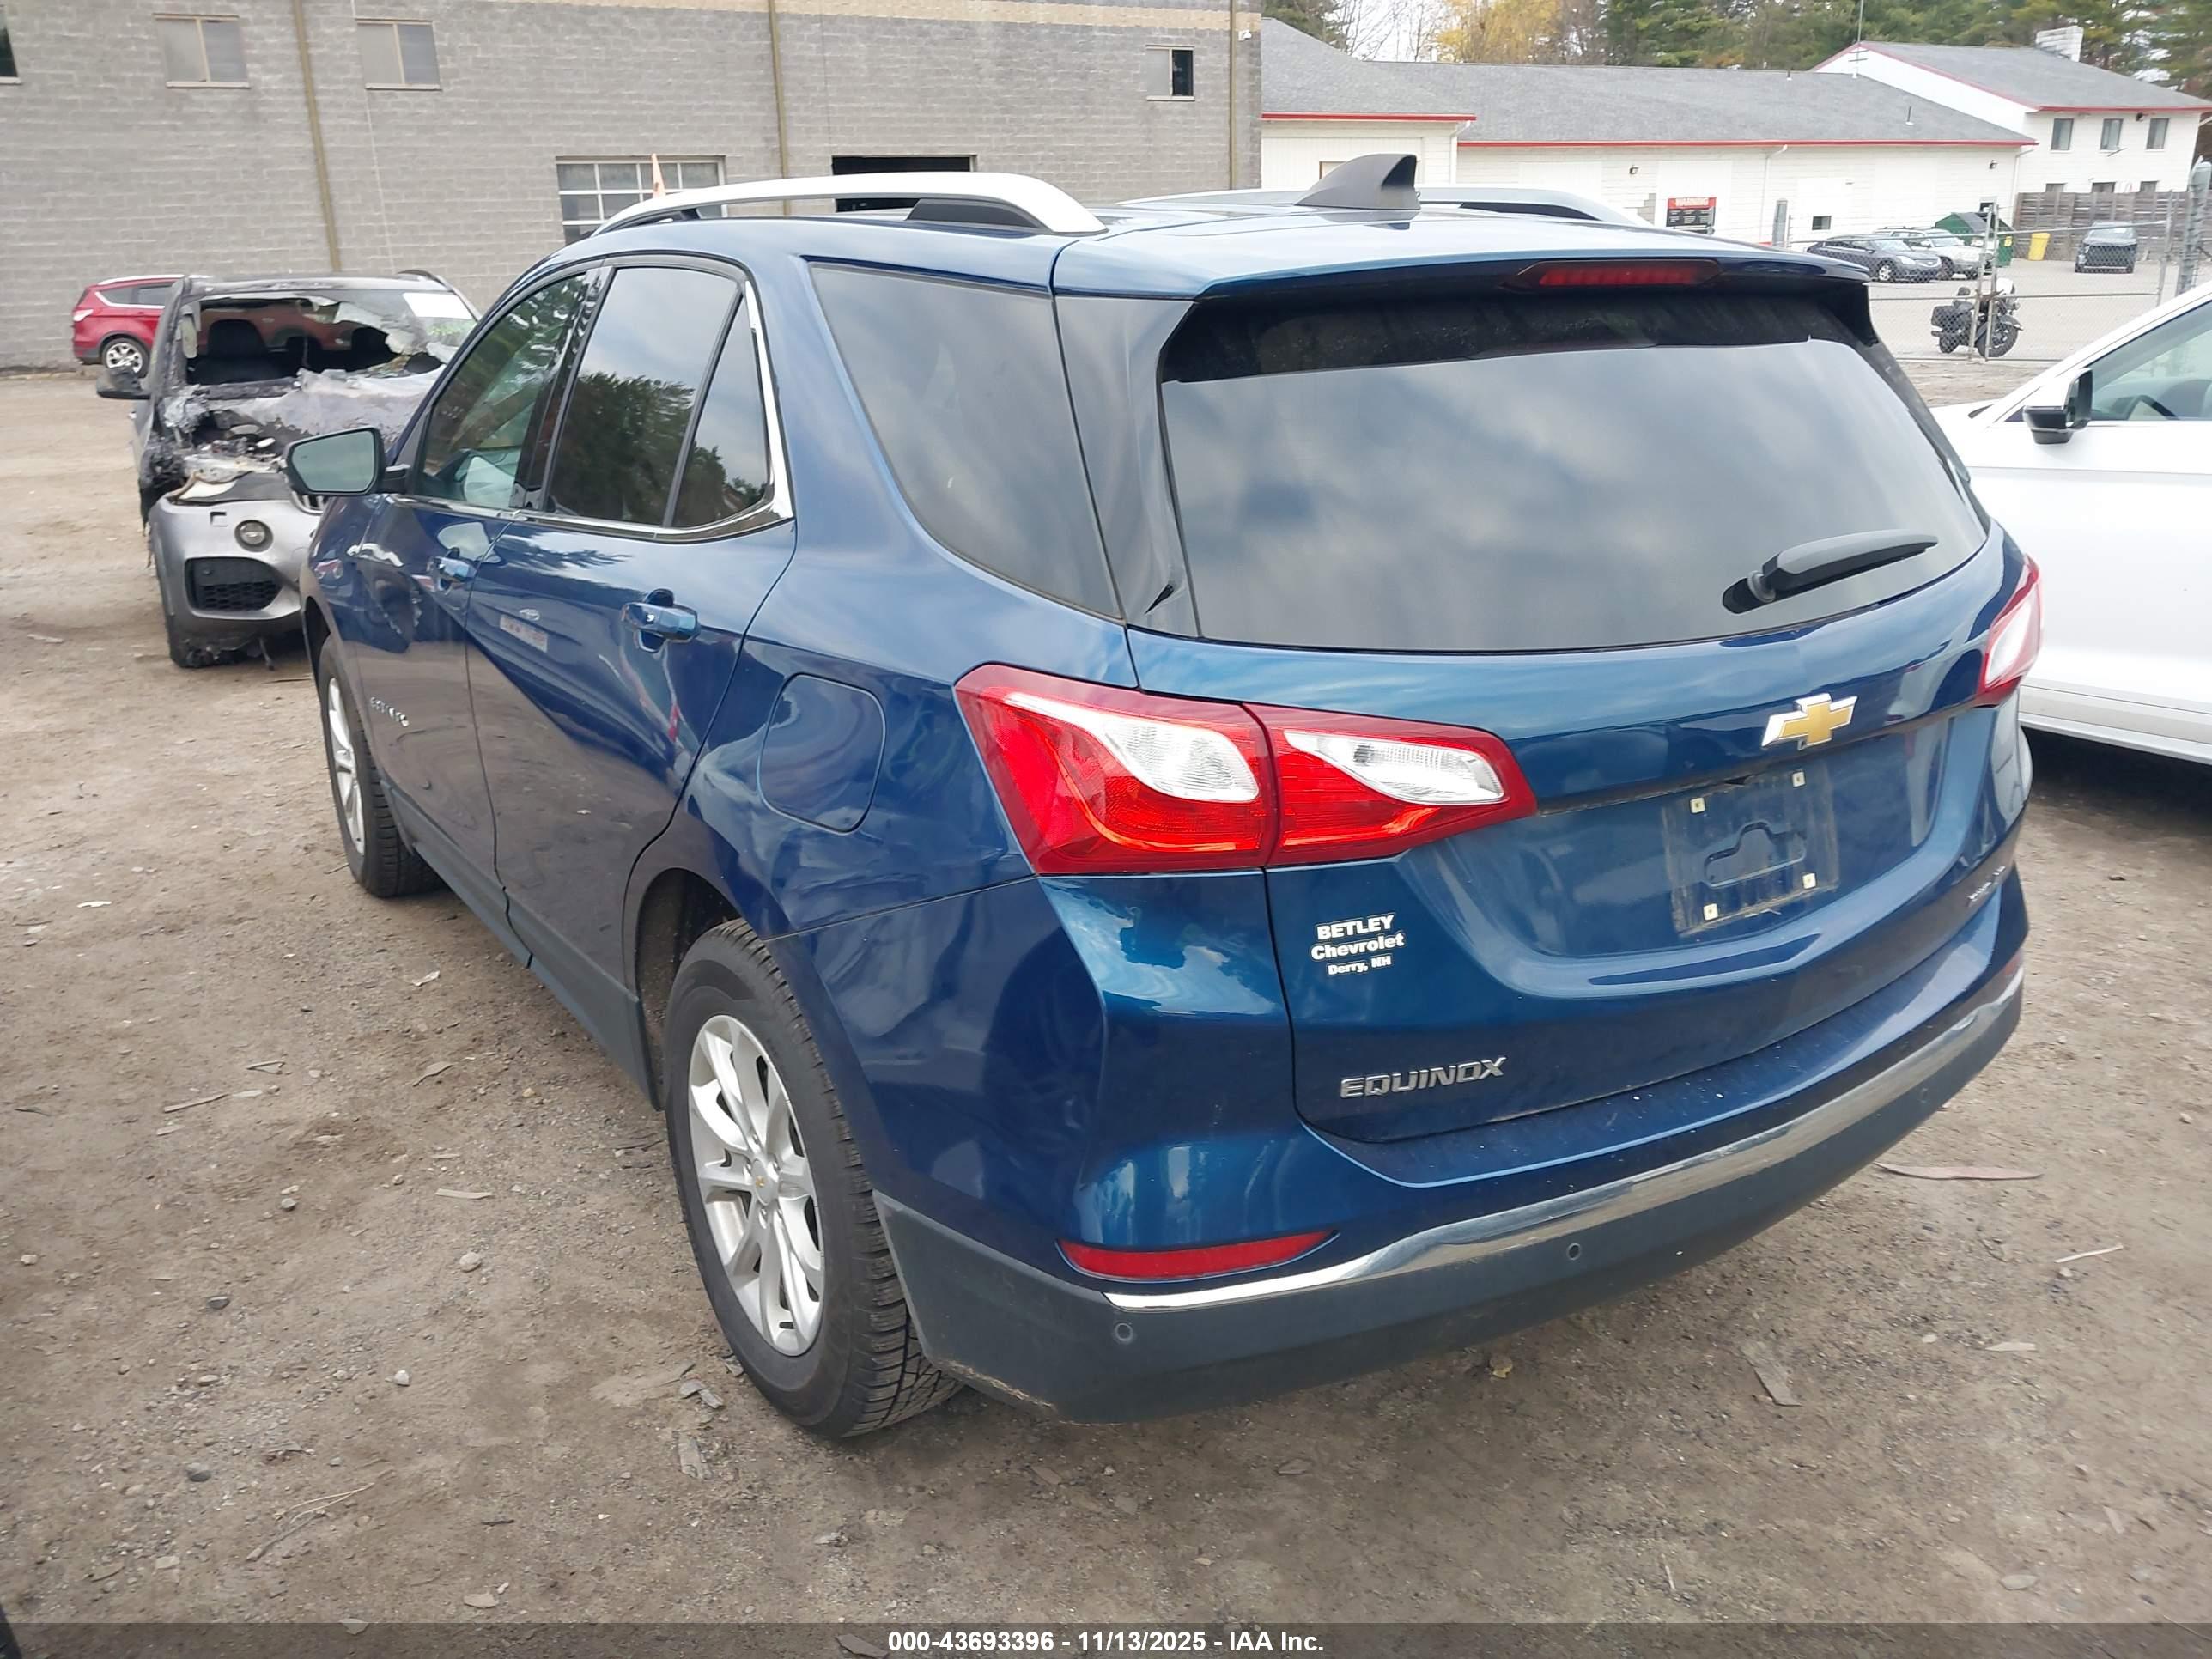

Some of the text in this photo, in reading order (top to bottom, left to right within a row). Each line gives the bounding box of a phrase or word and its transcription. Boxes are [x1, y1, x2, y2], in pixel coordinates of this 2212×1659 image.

[1316, 915, 1395, 940] BETLEY
[1310, 933, 1404, 960] Chevrolet
[1328, 955, 1392, 975] Derry, NH
[1340, 1056, 1507, 1099] EQUINOX
